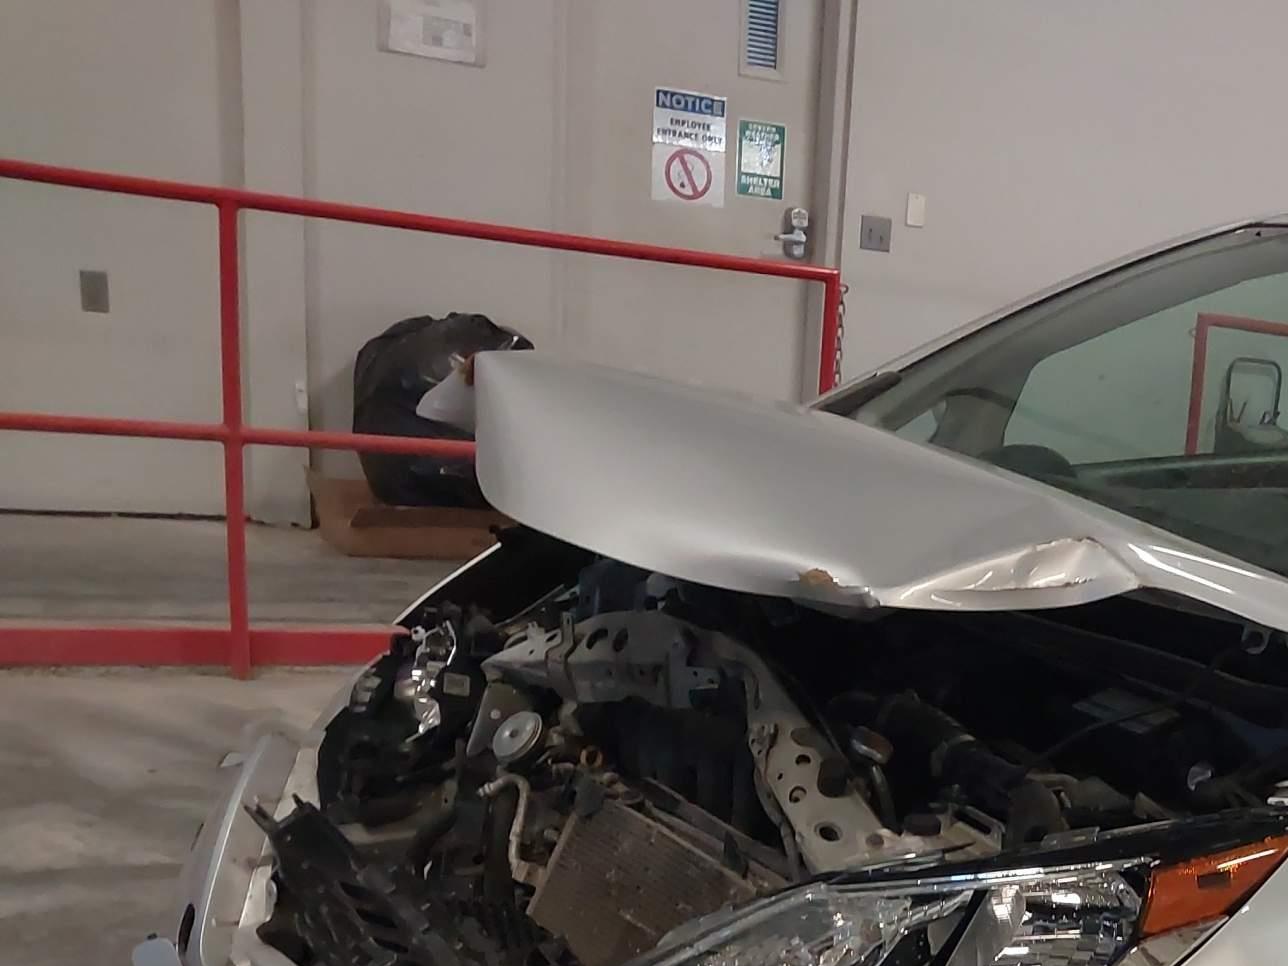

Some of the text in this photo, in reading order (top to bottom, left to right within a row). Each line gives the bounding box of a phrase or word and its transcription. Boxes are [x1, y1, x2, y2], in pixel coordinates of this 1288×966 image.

[658, 91, 724, 116] NOTICE
[670, 118, 711, 131] EMPLOYEE
[657, 128, 723, 145] ENTRANCE ONLY
[741, 174, 780, 188] SHELTER
